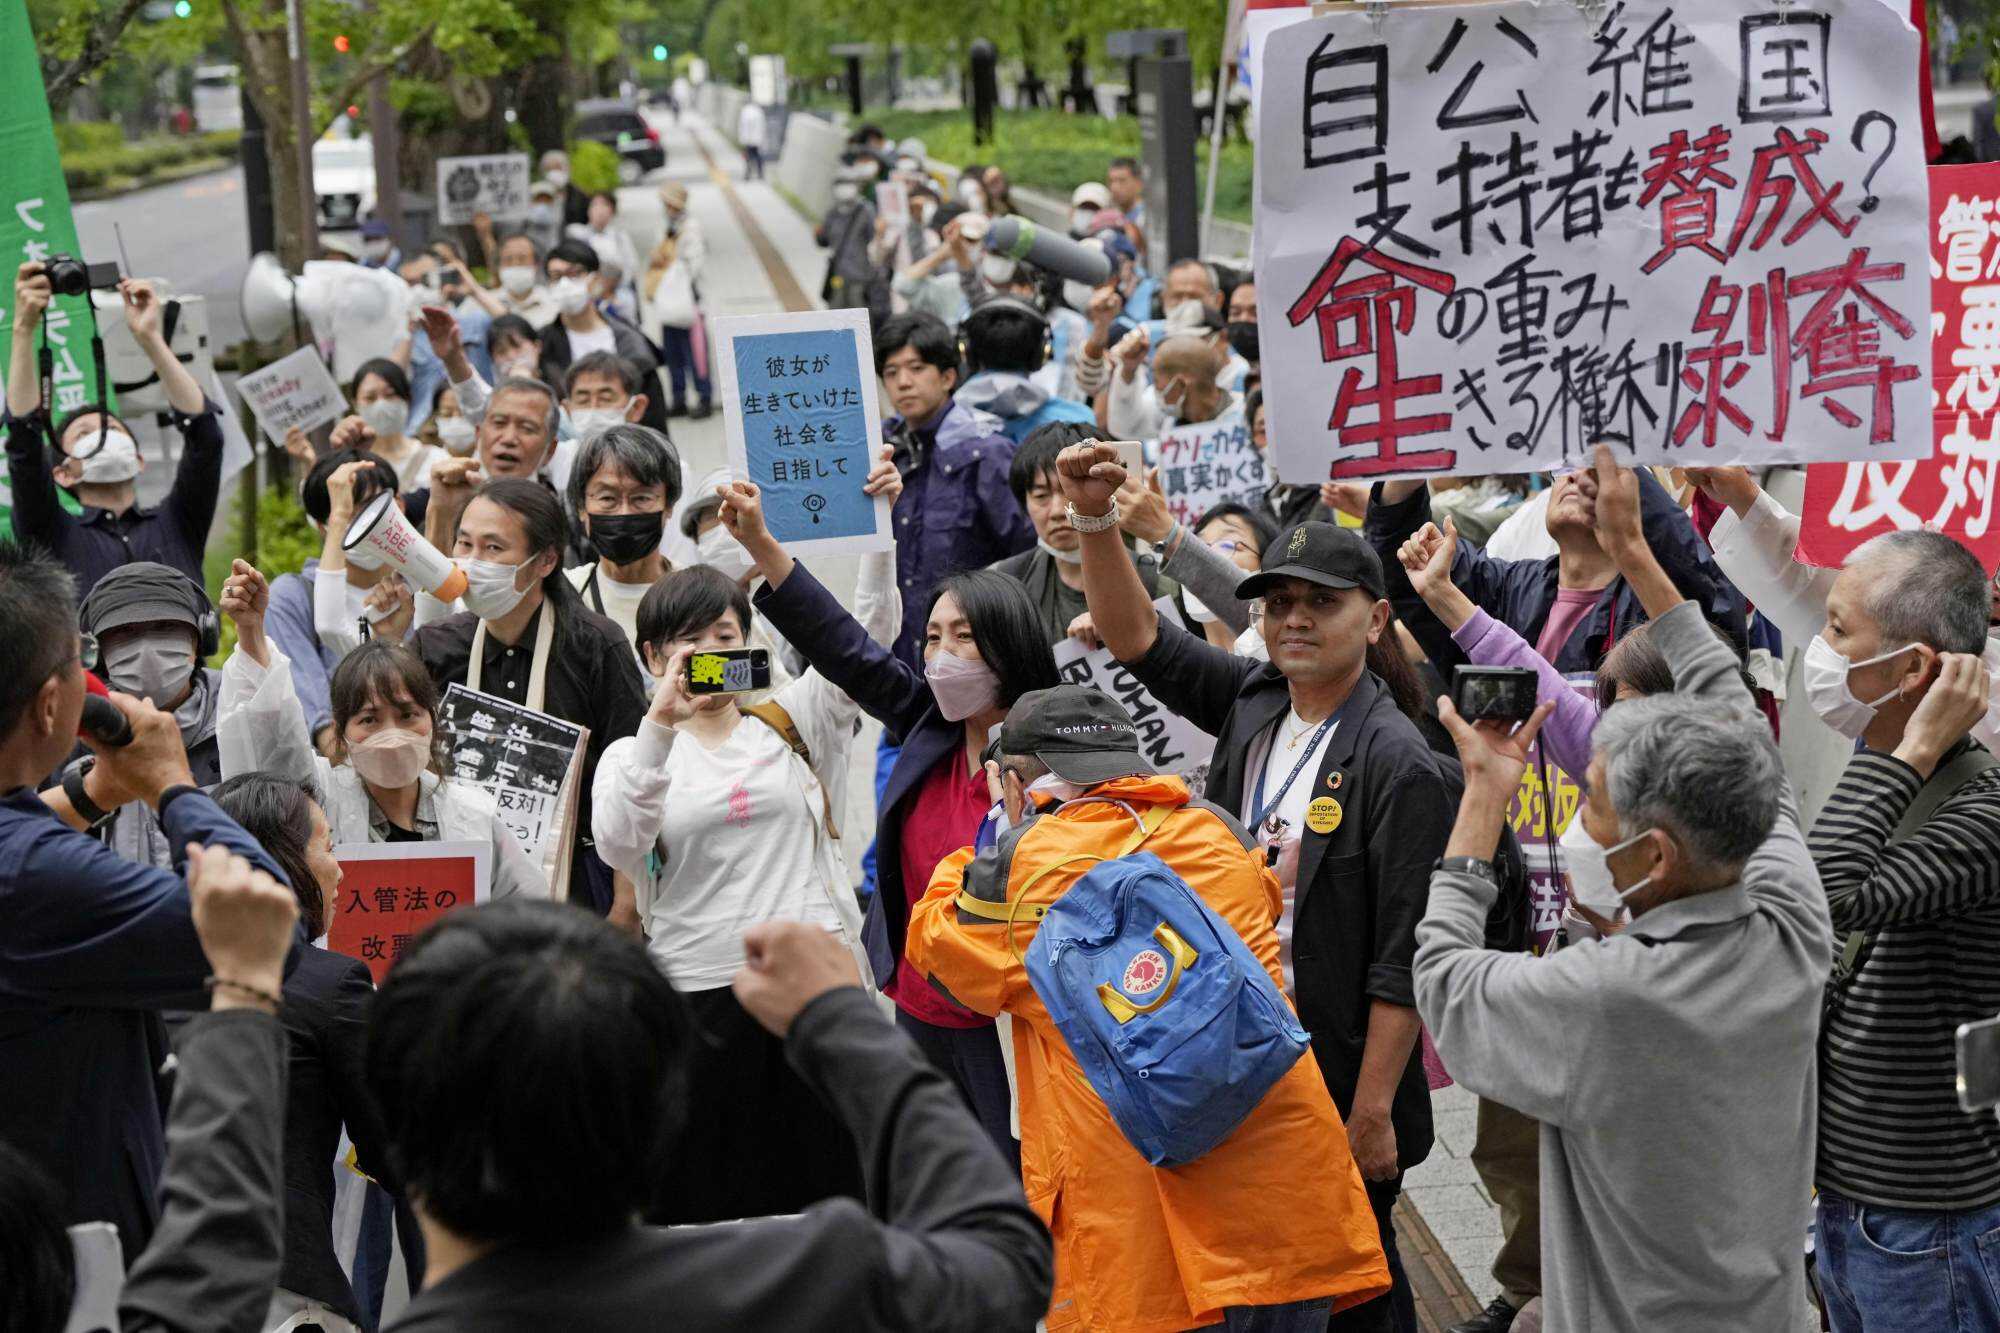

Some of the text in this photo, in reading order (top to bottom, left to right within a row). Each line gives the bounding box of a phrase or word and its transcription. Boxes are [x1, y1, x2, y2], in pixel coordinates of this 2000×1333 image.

[1304, 2, 1831, 168] 自公維国
[1354, 110, 1898, 275] 支持者も賛成?
[1287, 235, 1630, 366] 命の重み
[766, 354, 830, 378] 彼女が
[744, 388, 859, 415] 生きていけた
[774, 423, 836, 447] 社会を
[772, 457, 849, 483] 目指して
[1104, 660, 1184, 766] UMAN
[1055, 725, 1098, 734] TOMMY
[484, 786, 545, 816] 反対!
[1311, 804, 1337, 812] STOP!
[345, 886, 457, 914] 入管法の
